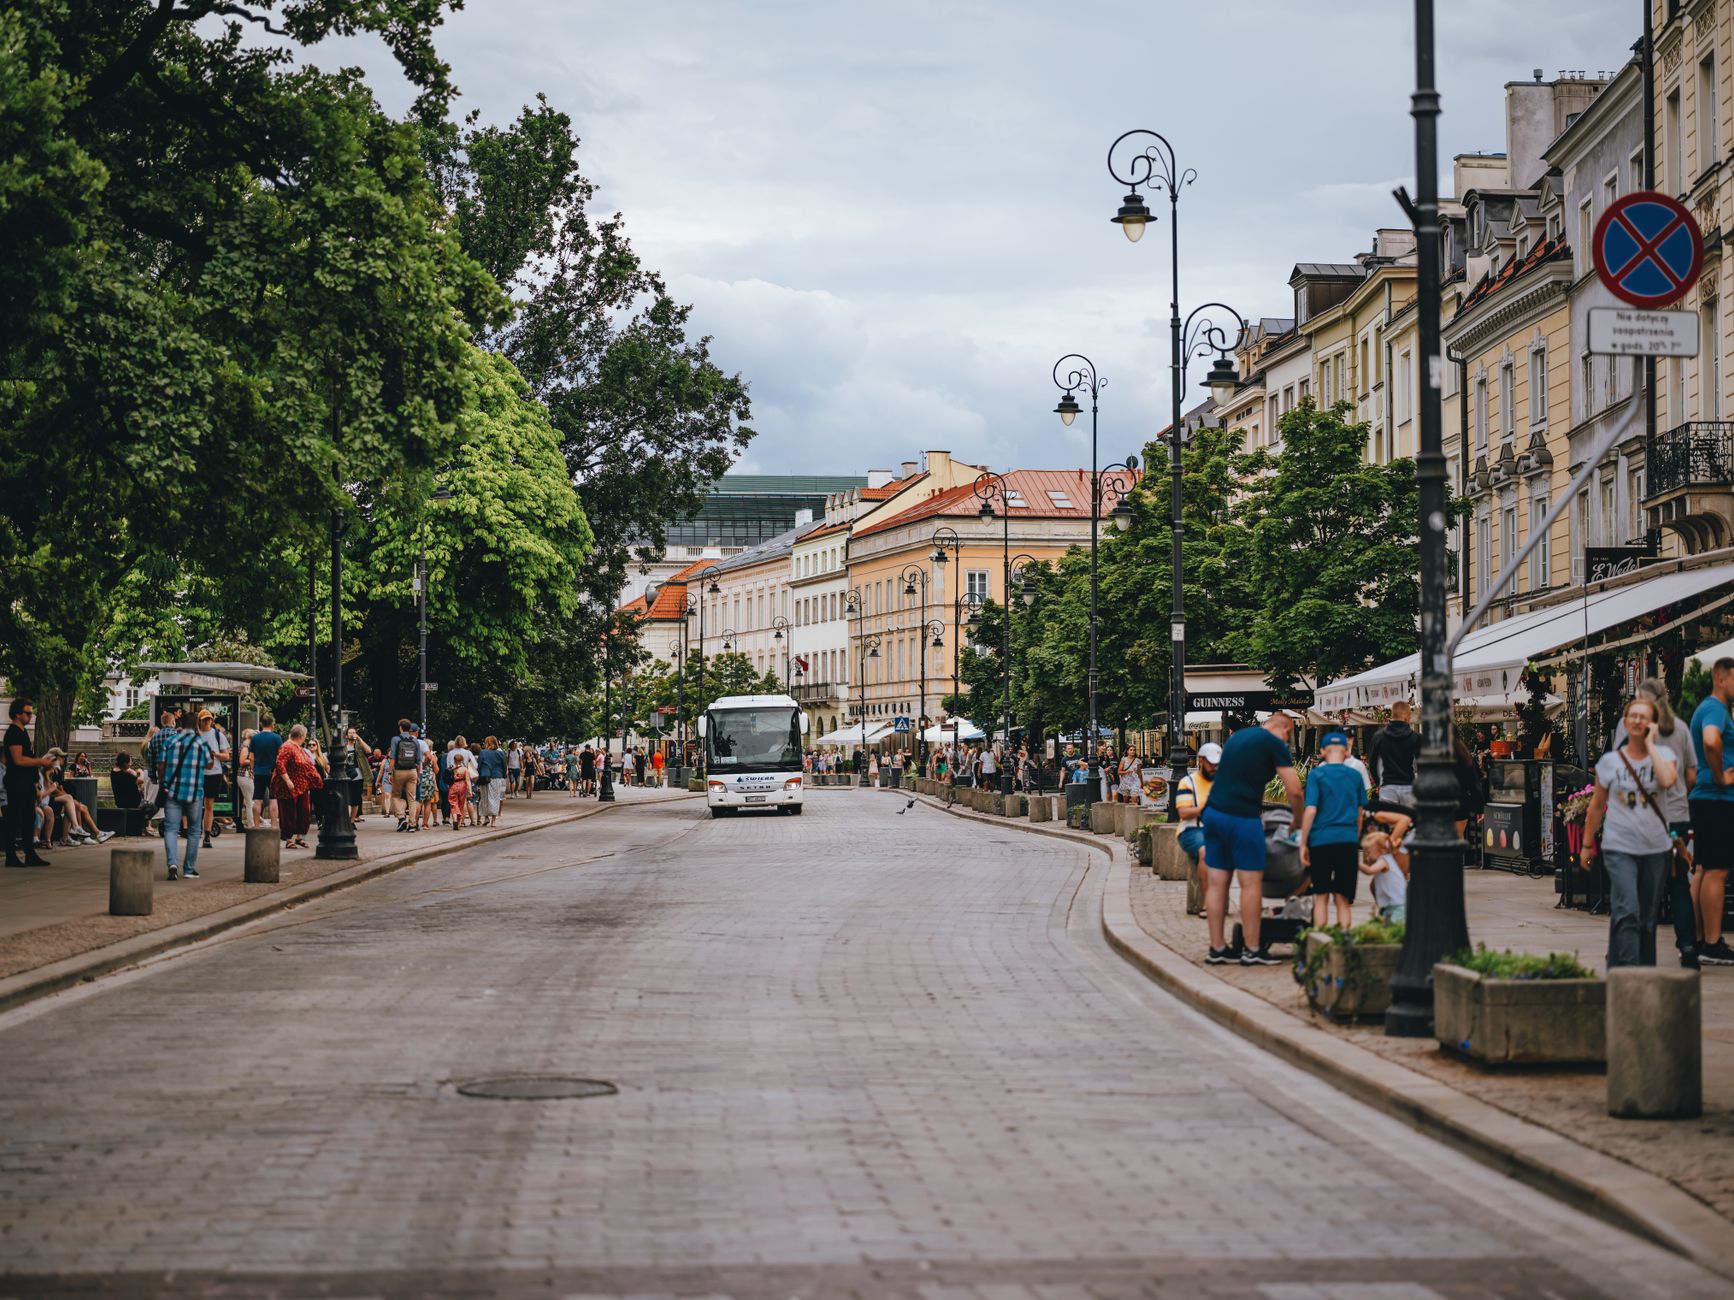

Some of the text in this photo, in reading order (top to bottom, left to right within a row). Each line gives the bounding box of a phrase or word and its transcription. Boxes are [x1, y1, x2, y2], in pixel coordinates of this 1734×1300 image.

[1616, 311, 1669, 324] Nie dotyczy
[1193, 697, 1245, 708] GUINNESS
